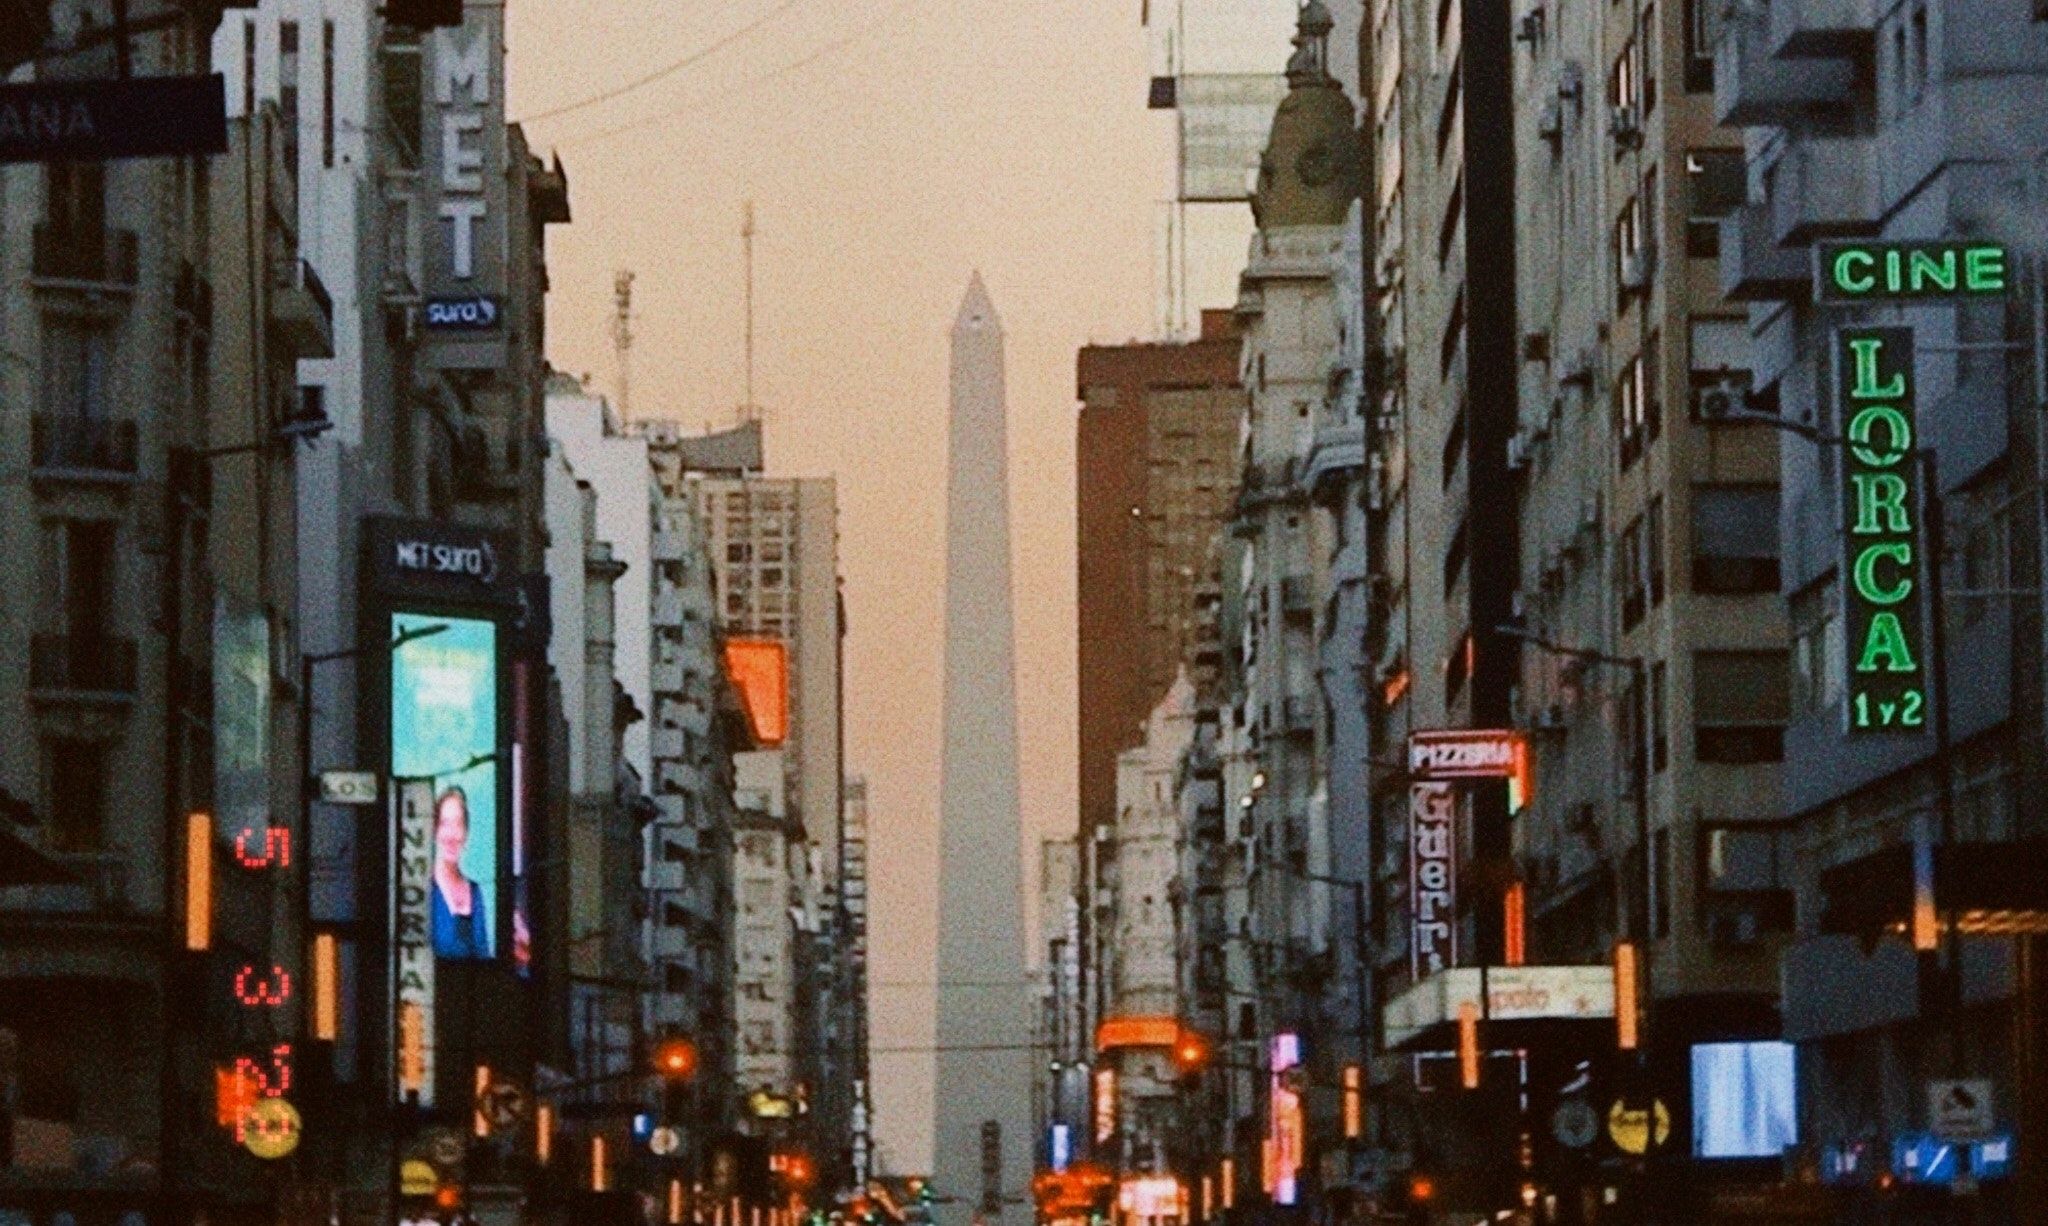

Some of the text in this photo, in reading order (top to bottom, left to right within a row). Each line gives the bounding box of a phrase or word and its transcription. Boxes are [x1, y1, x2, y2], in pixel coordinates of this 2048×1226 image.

[1833, 247, 2006, 292] CINE
[1849, 337, 1917, 672] LORCA
[1854, 692, 1871, 727] 1
[1902, 689, 1925, 726] 2
